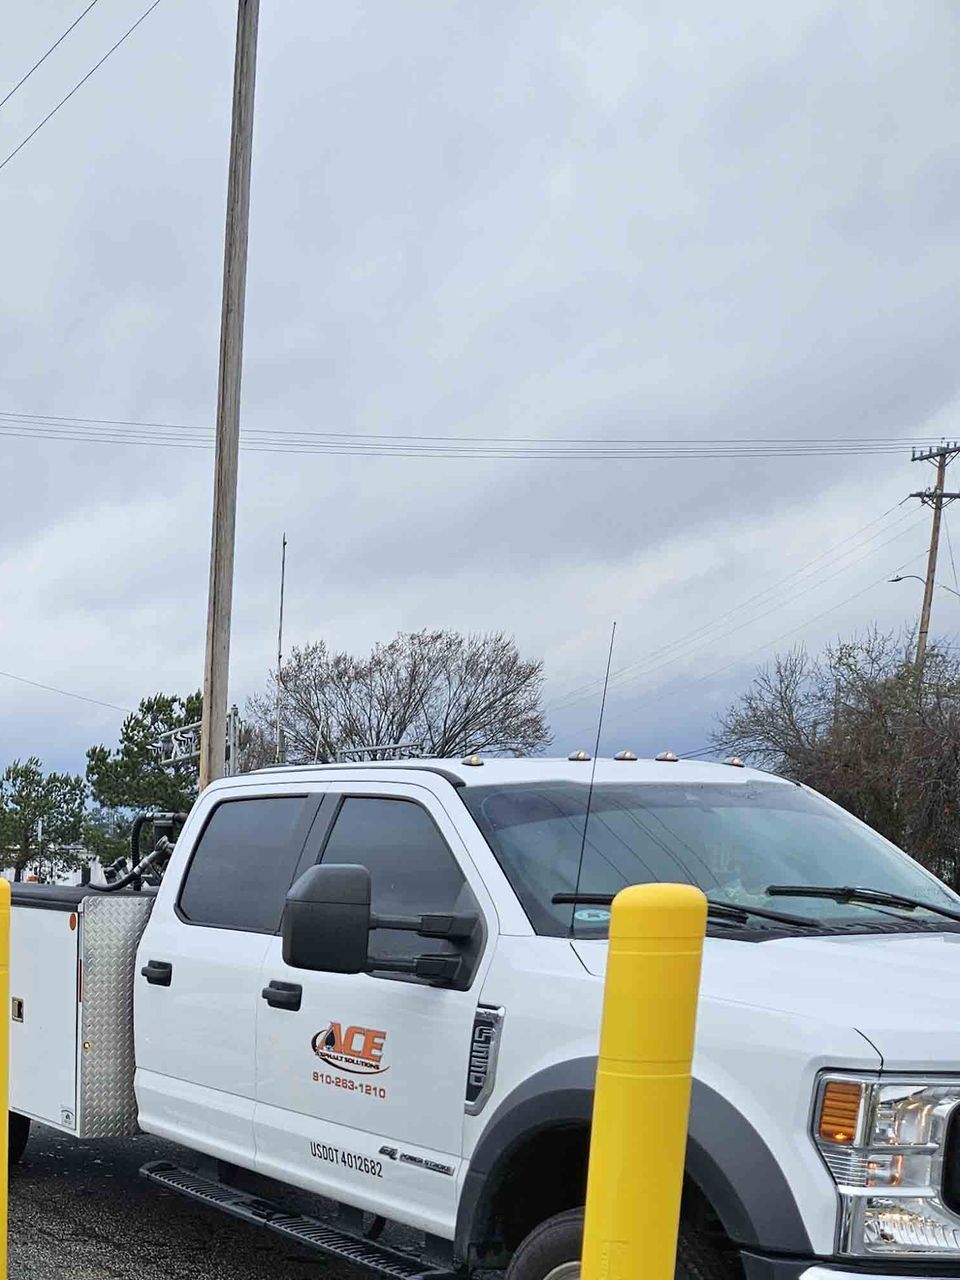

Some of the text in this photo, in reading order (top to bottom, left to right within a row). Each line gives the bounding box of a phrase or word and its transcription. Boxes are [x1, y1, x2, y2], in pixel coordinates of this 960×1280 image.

[318, 1022, 387, 1063] ACE
[344, 1056, 381, 1070] SOLUTIONS
[312, 1071, 387, 1099] 910-263-1210
[310, 1141, 339, 1164] USDOT
[340, 1151, 383, 1178] 4012682
